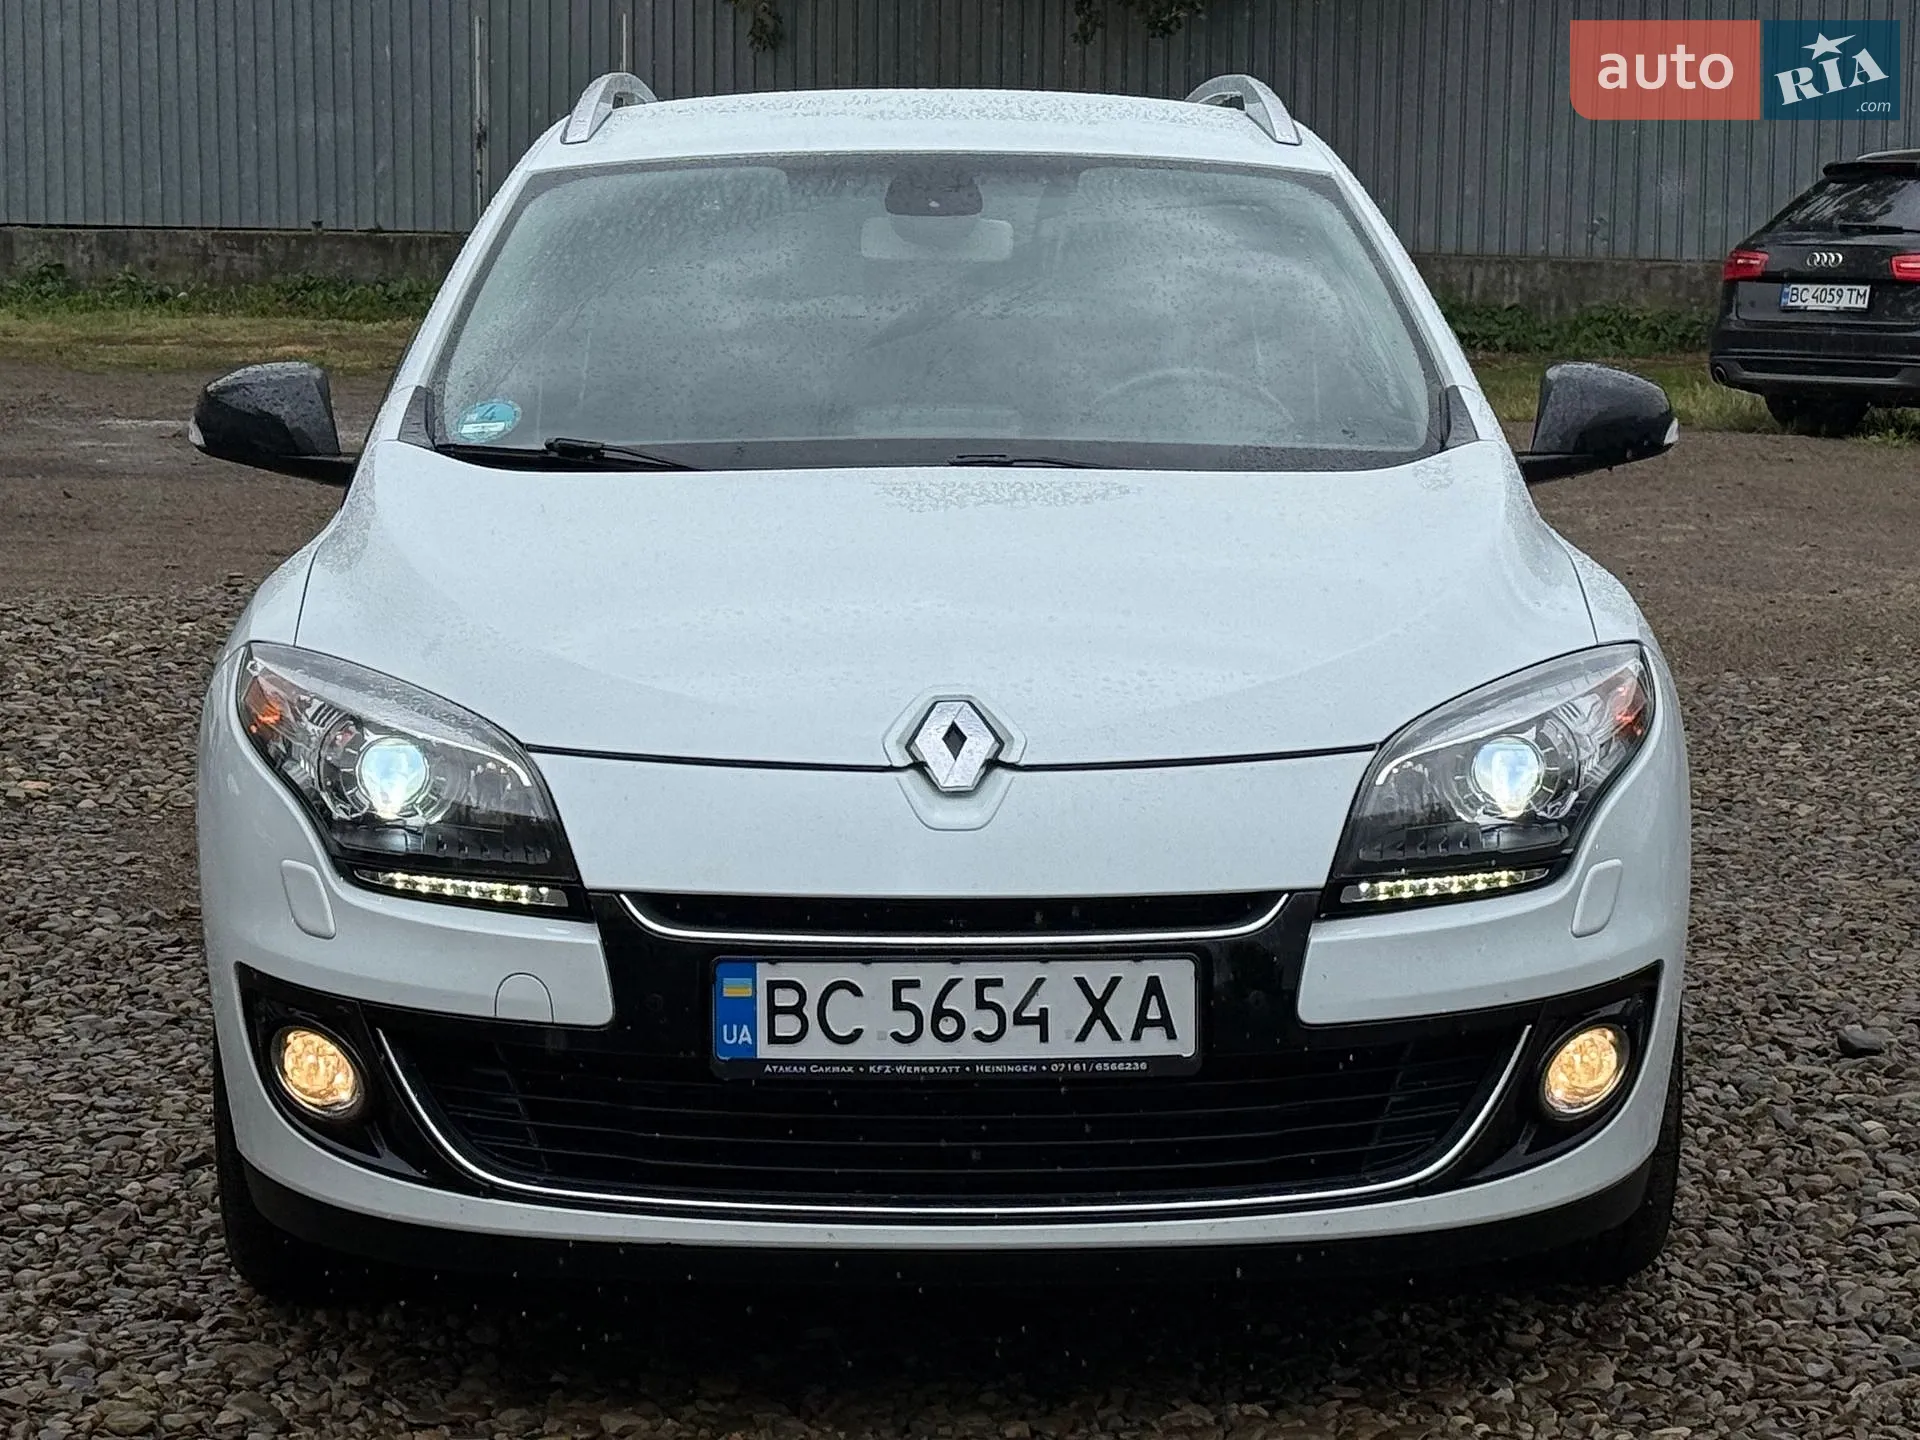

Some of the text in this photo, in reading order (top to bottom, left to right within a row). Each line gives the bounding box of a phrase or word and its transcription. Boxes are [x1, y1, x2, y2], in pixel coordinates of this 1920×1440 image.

[1789, 287, 1810, 303] BC
[1812, 288, 1843, 305] 4059
[1847, 289, 1867, 305] TM
[765, 975, 1178, 1045] BC 5654 XA
[722, 1024, 753, 1046] UA
